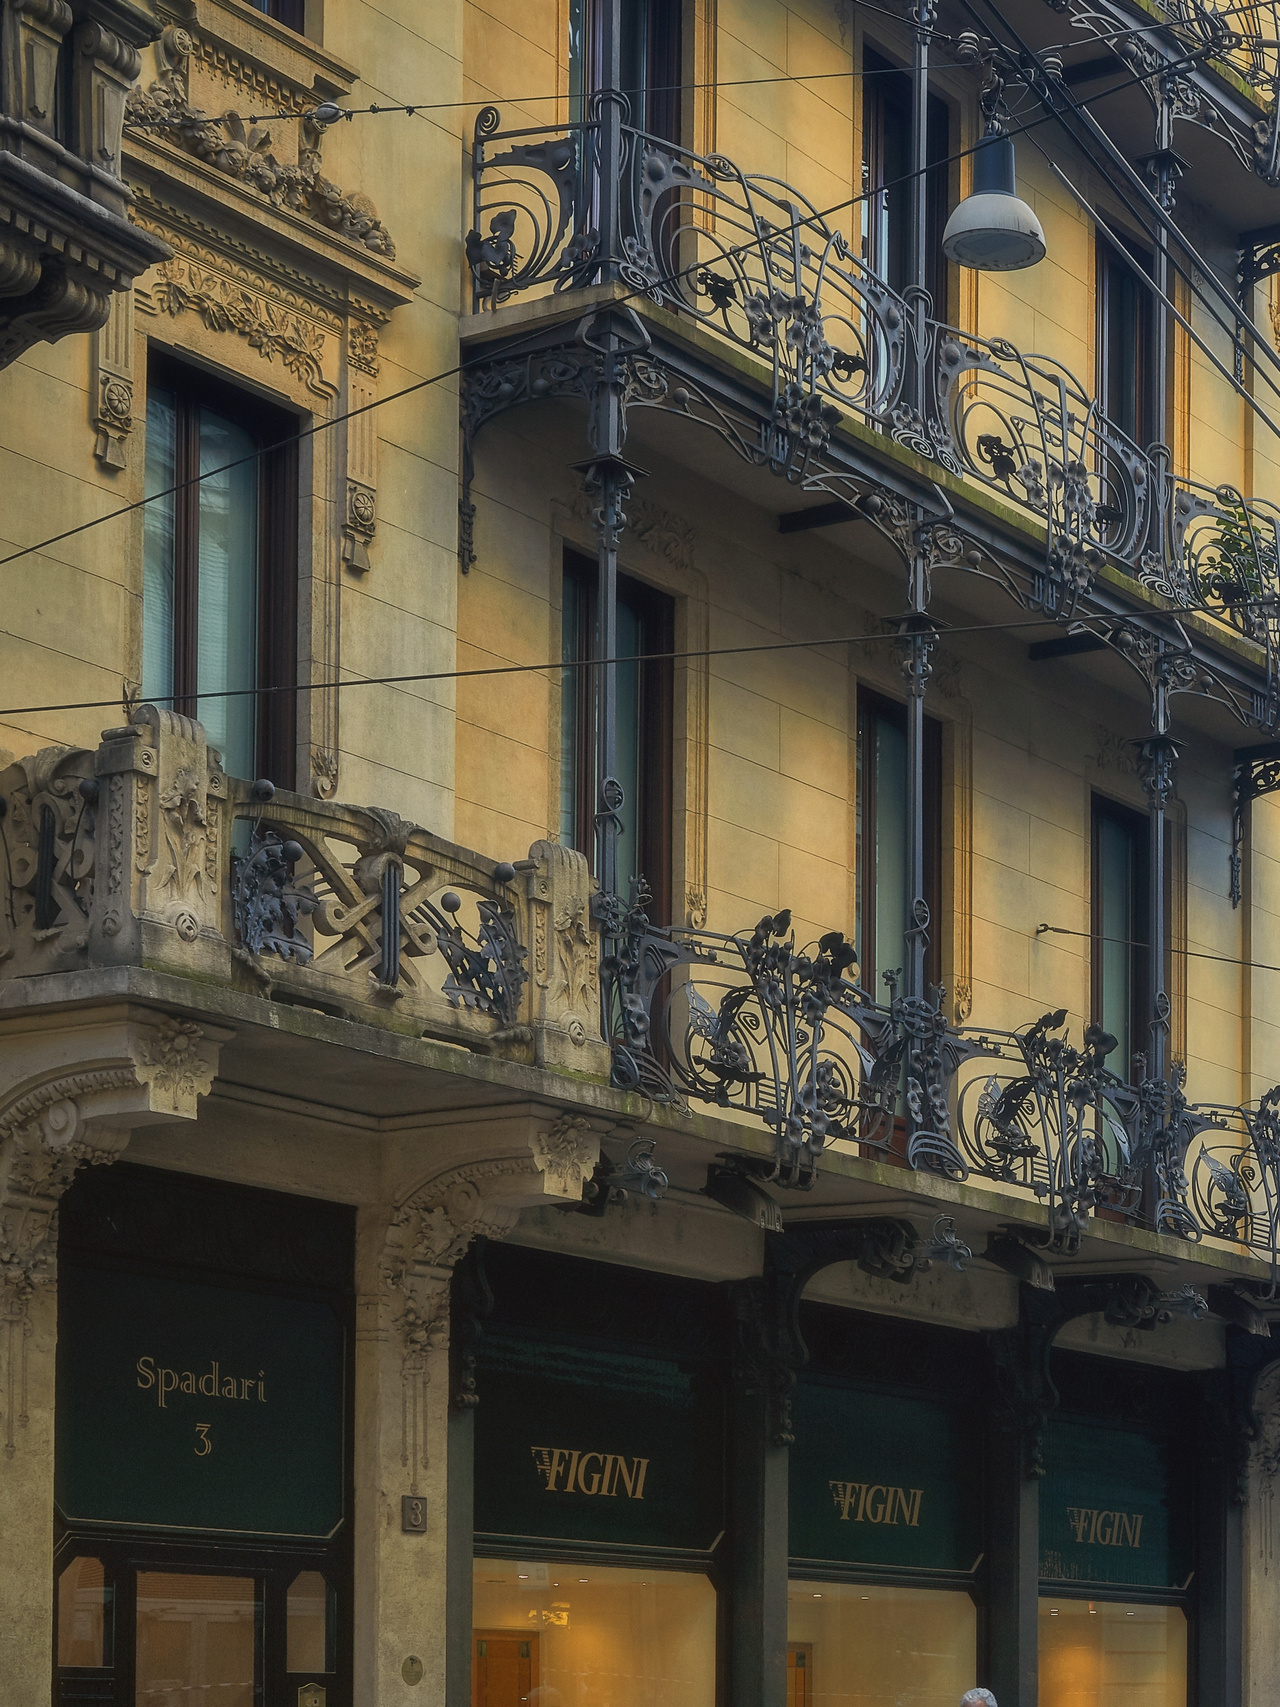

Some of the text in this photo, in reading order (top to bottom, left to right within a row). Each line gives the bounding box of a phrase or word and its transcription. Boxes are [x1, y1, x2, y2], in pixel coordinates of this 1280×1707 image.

[136, 1356, 267, 1408] Spadari
[194, 1423, 212, 1456] 3
[531, 1446, 650, 1499] FIGINI
[411, 1501, 422, 1526] 3
[828, 1480, 925, 1527] FIGINI
[1066, 1506, 1144, 1549] FIGINI
